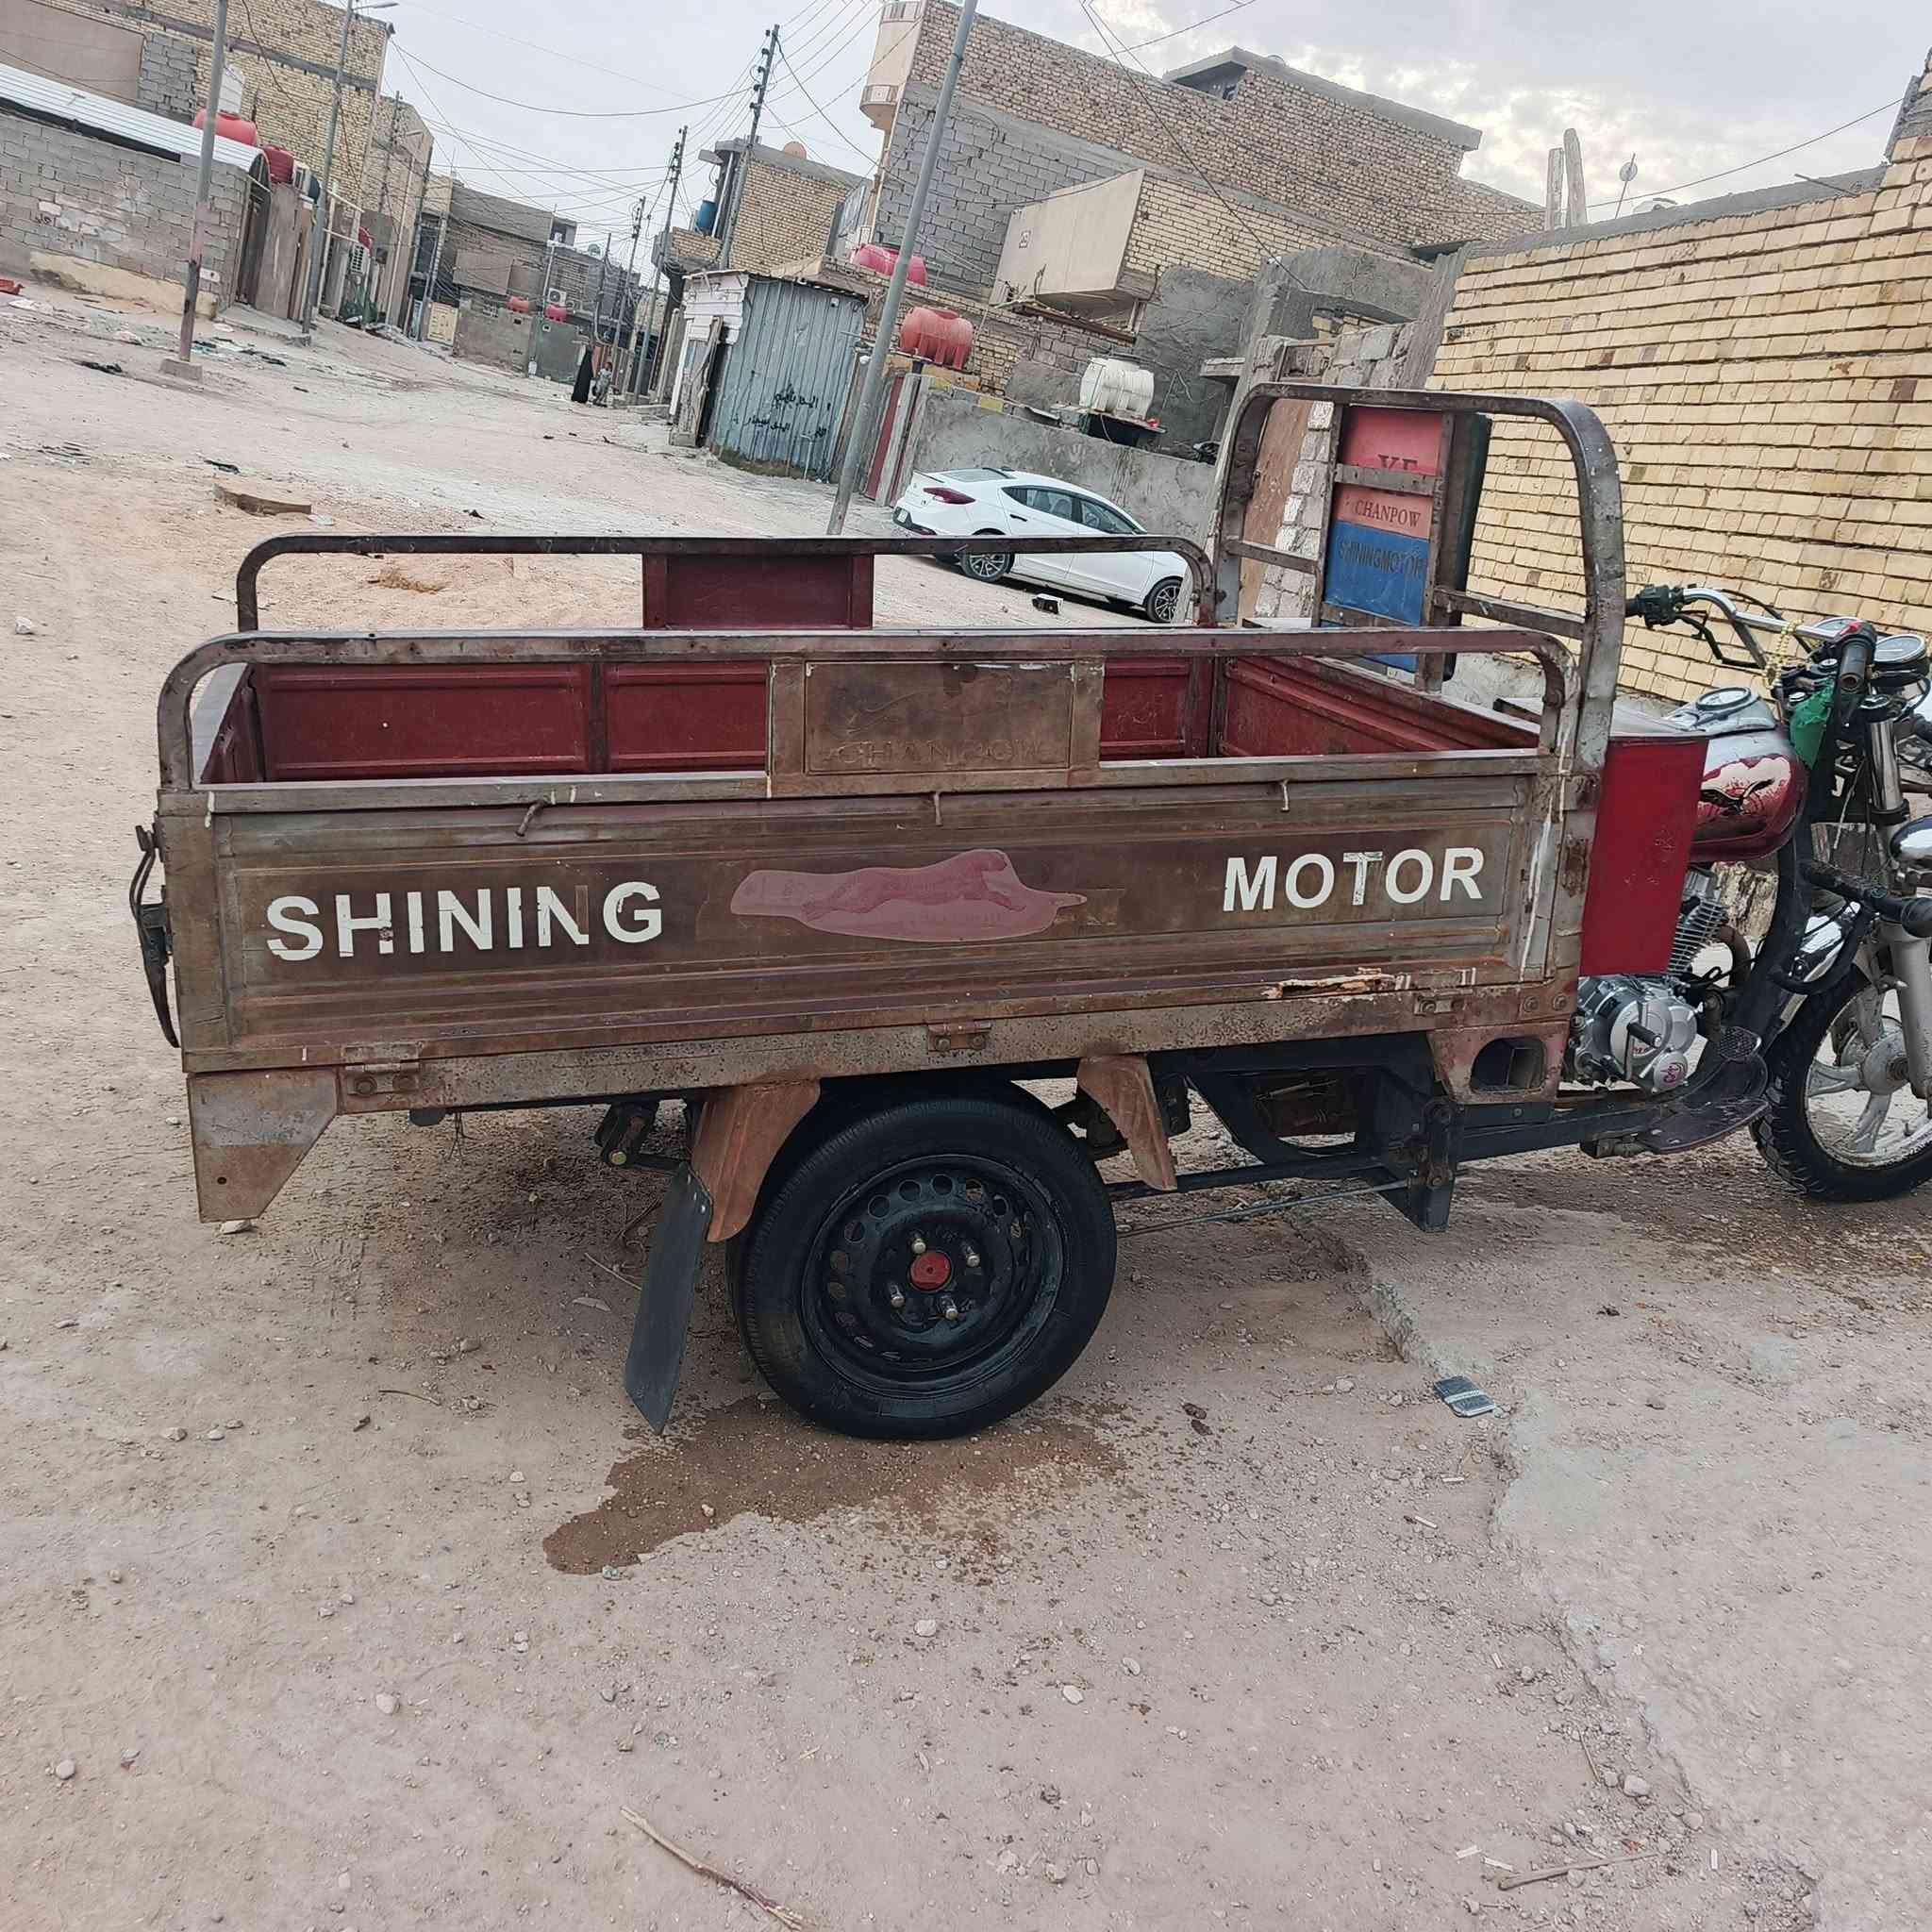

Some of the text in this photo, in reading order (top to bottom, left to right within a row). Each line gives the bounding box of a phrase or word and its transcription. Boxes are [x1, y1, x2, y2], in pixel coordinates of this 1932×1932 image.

[1356, 499, 1421, 527] CHANPOW
[266, 847, 1485, 961] SHINING MOTOR
